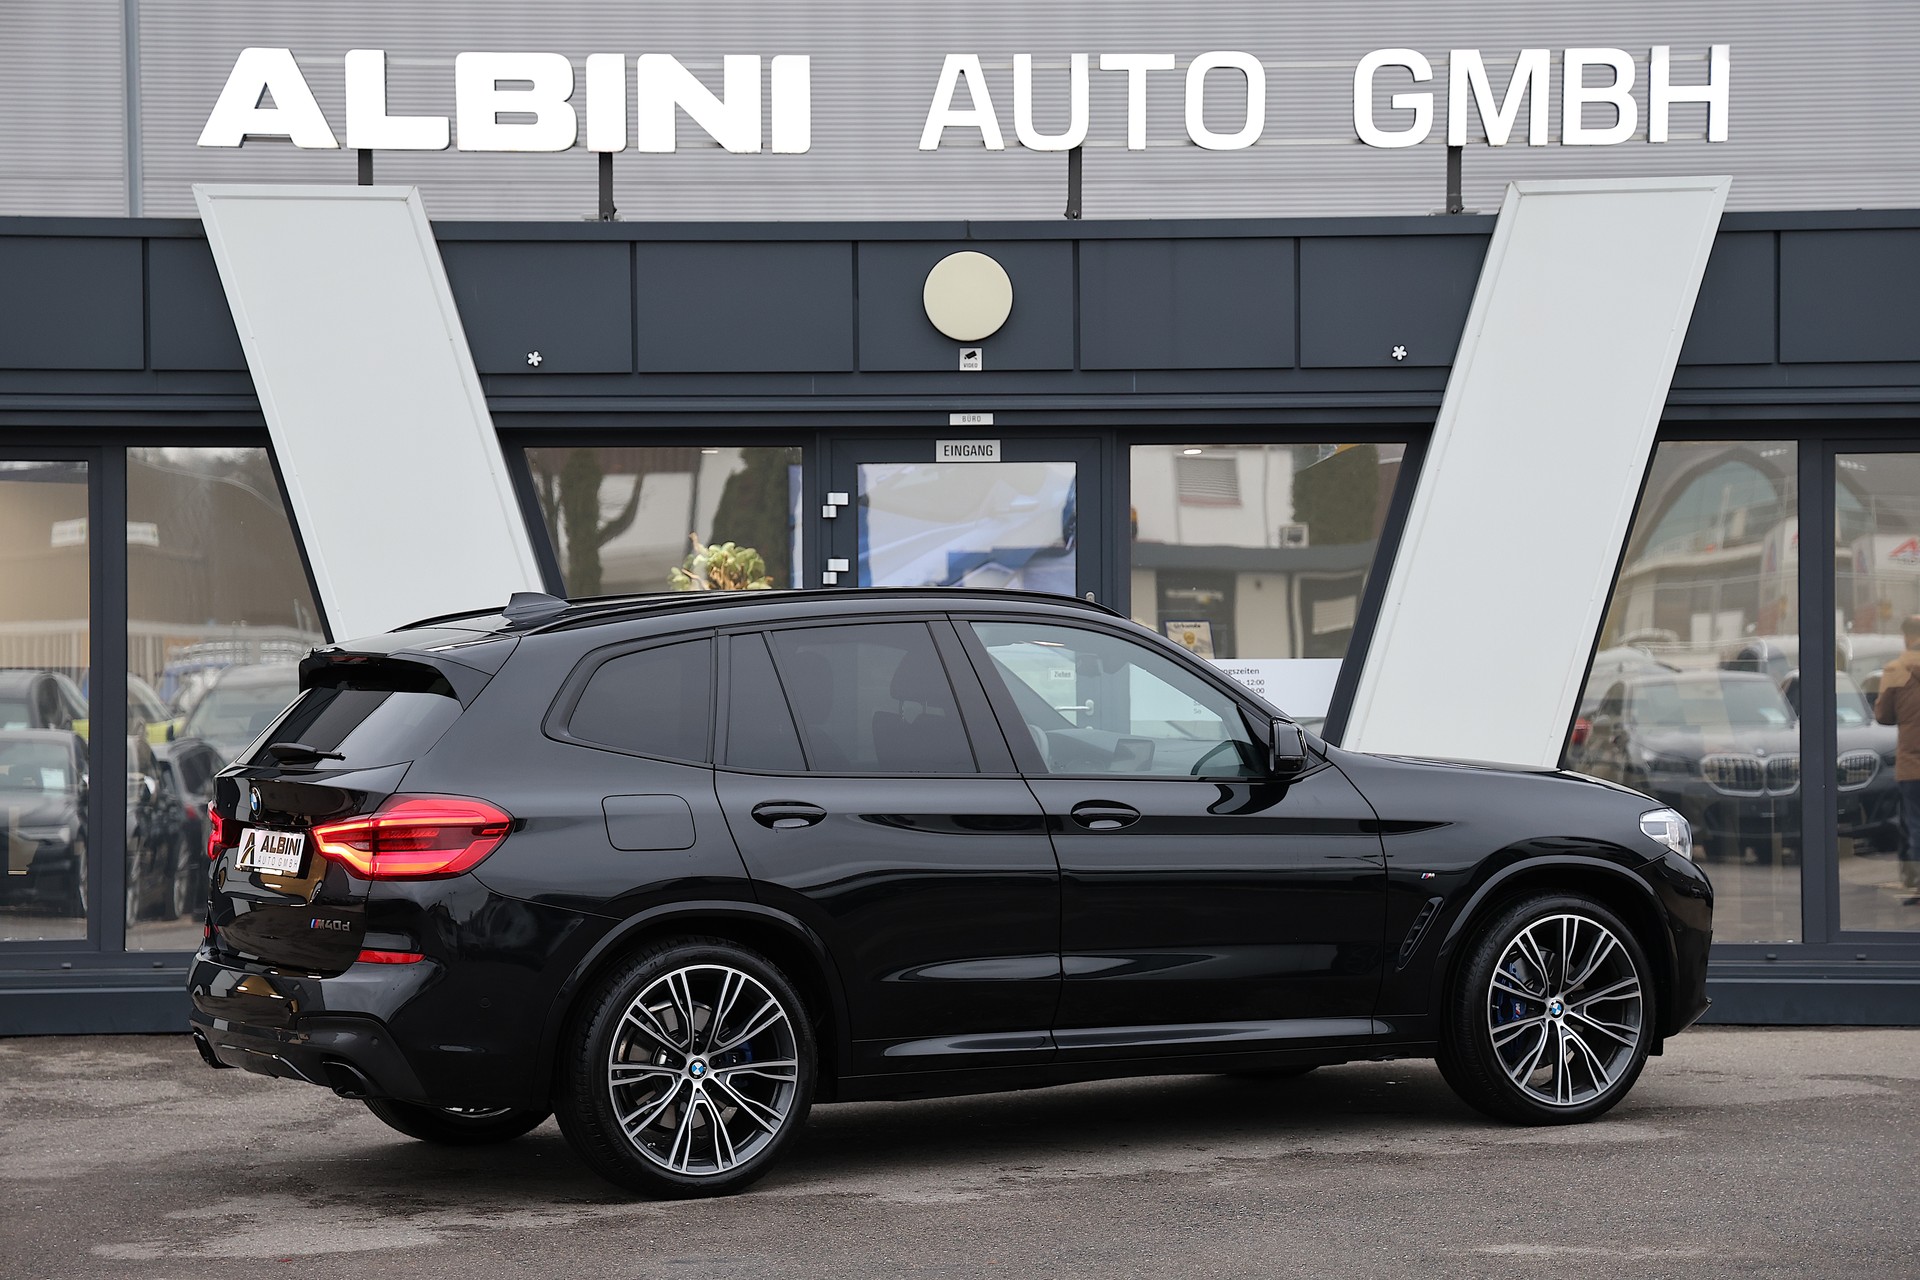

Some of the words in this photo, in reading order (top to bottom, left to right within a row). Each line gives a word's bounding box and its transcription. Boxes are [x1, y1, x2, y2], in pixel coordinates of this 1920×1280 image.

[196, 47, 812, 154] ALBINI
[918, 50, 1267, 152] AUTO
[1353, 44, 1731, 148] GMBH
[962, 415, 982, 423] BÜRO
[944, 445, 993, 457] EINGANG
[260, 835, 302, 856] ALBINI
[258, 855, 276, 867] AUTO
[278, 857, 298, 868] GMBH
